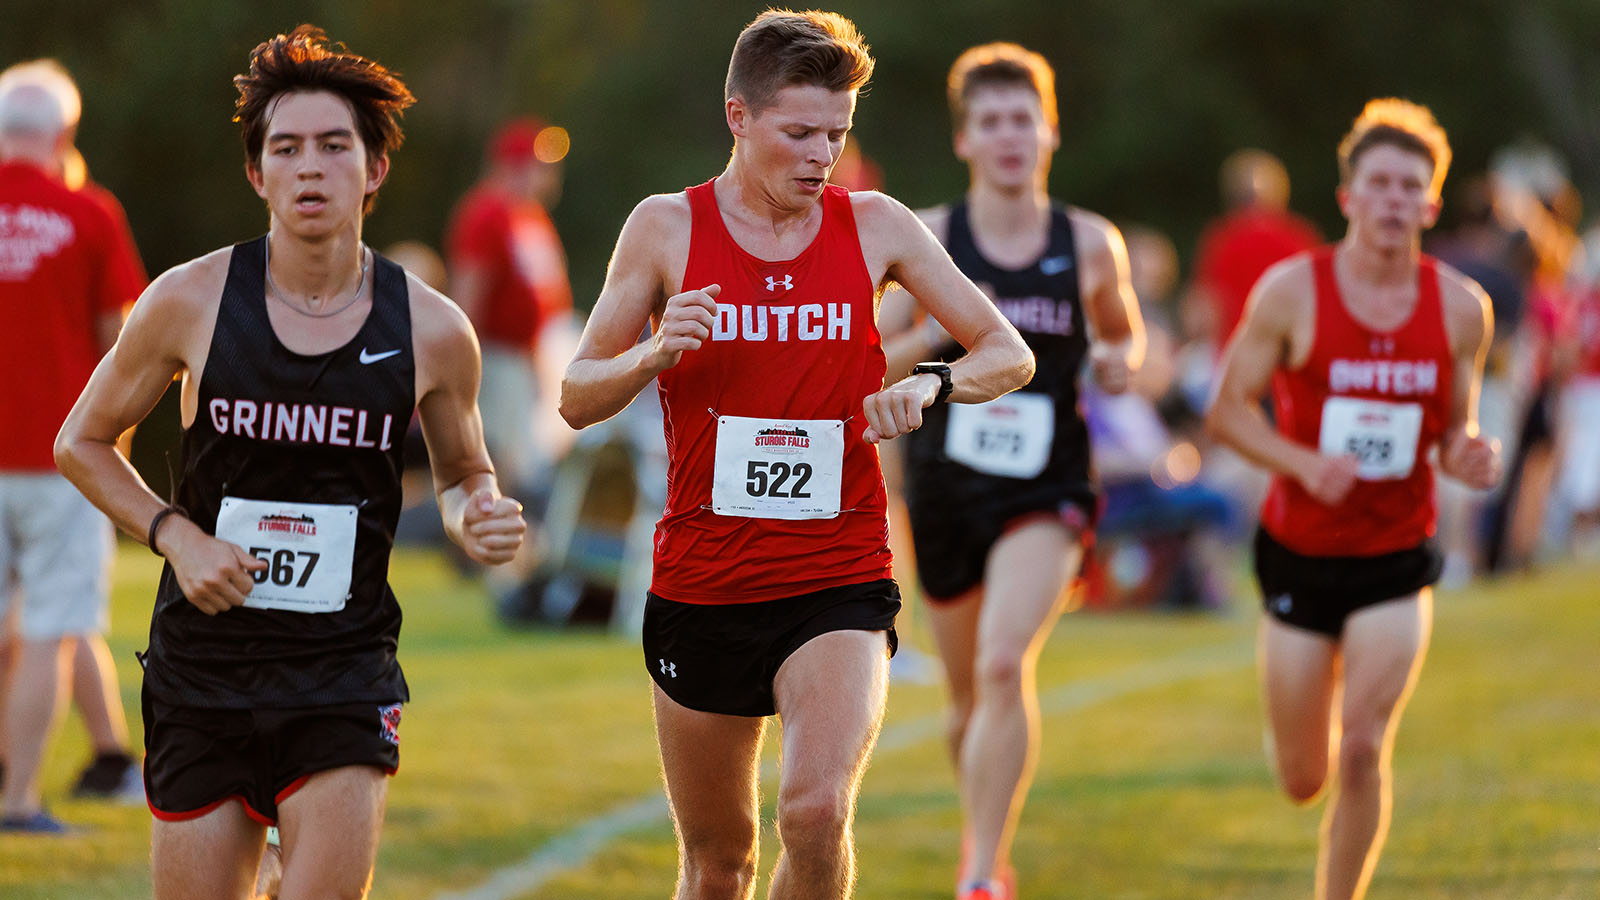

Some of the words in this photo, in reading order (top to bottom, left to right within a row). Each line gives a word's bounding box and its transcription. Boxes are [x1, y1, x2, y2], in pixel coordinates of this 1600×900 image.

[711, 302, 851, 342] DUTCH
[1329, 359, 1437, 394] DUTCH
[209, 398, 393, 451] GRINNELL
[755, 435, 787, 446] STURGIS
[787, 437, 810, 448] FALLS
[746, 460, 813, 499] 522
[292, 523, 316, 536] FALLS
[248, 546, 320, 588] 567
